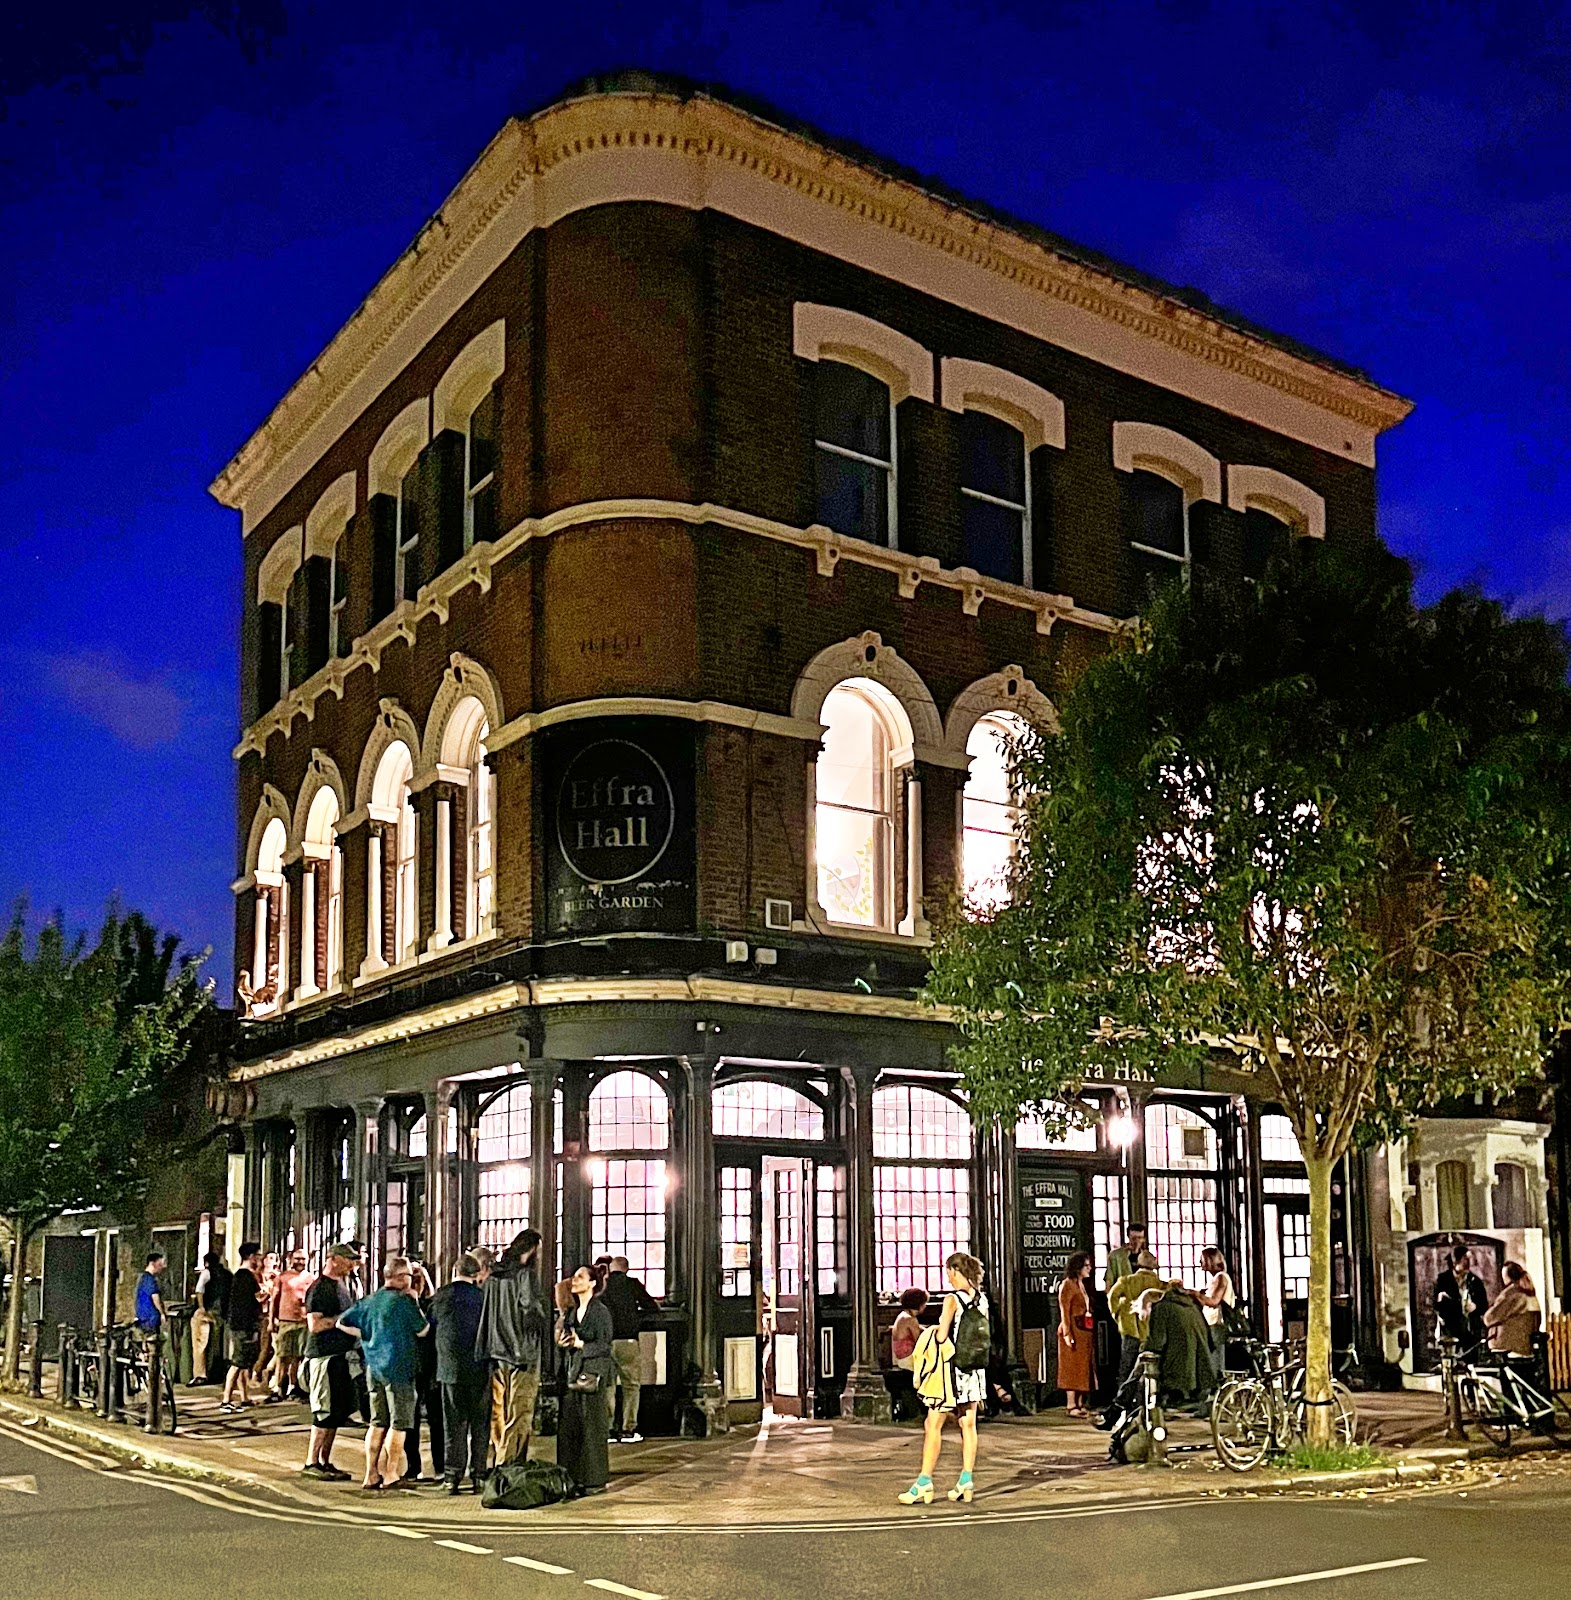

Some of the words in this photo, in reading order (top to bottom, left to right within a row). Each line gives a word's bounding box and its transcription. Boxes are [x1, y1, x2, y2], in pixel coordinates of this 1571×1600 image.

[571, 775, 656, 809] Effra
[576, 816, 650, 850] Hall
[564, 899, 596, 913] BEER
[598, 896, 664, 909] GARDEN
[1022, 1184, 1034, 1198] THE
[1035, 1182, 1057, 1195] EFFRA
[1057, 1184, 1073, 1199] HALL
[1044, 1214, 1075, 1229] FOOD
[1023, 1234, 1035, 1248] BIG
[1035, 1234, 1061, 1248] SCREEN
[1024, 1255, 1043, 1268] BEER
[1025, 1276, 1048, 1293] LIVE
